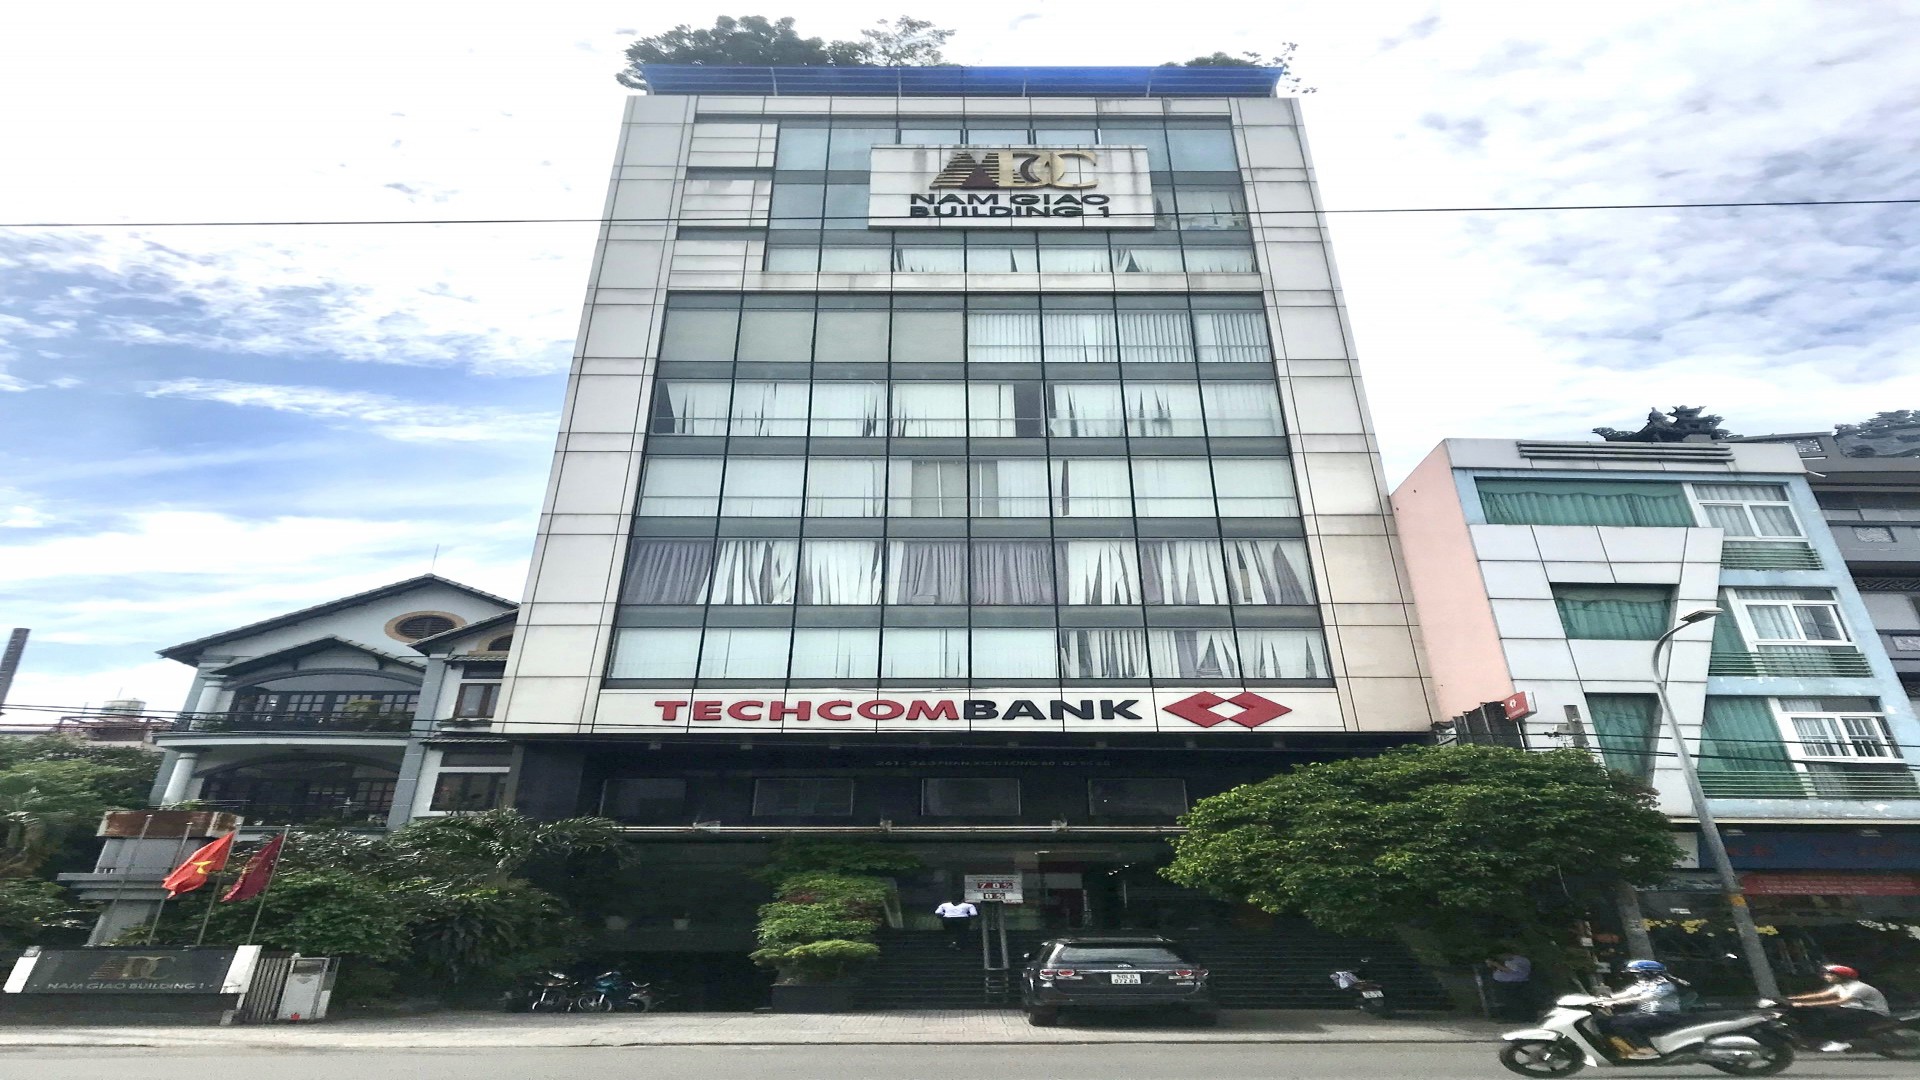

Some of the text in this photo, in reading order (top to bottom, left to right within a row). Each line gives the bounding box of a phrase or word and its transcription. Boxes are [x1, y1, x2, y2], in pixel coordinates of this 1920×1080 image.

[910, 193, 1111, 206] NAM GIAO
[909, 205, 1111, 218] BUILDING 1
[654, 699, 1143, 722] TECHCOMBANK
[47, 982, 83, 991] NAM
[86, 982, 127, 991] GIAO
[128, 982, 197, 991] BUILDING
